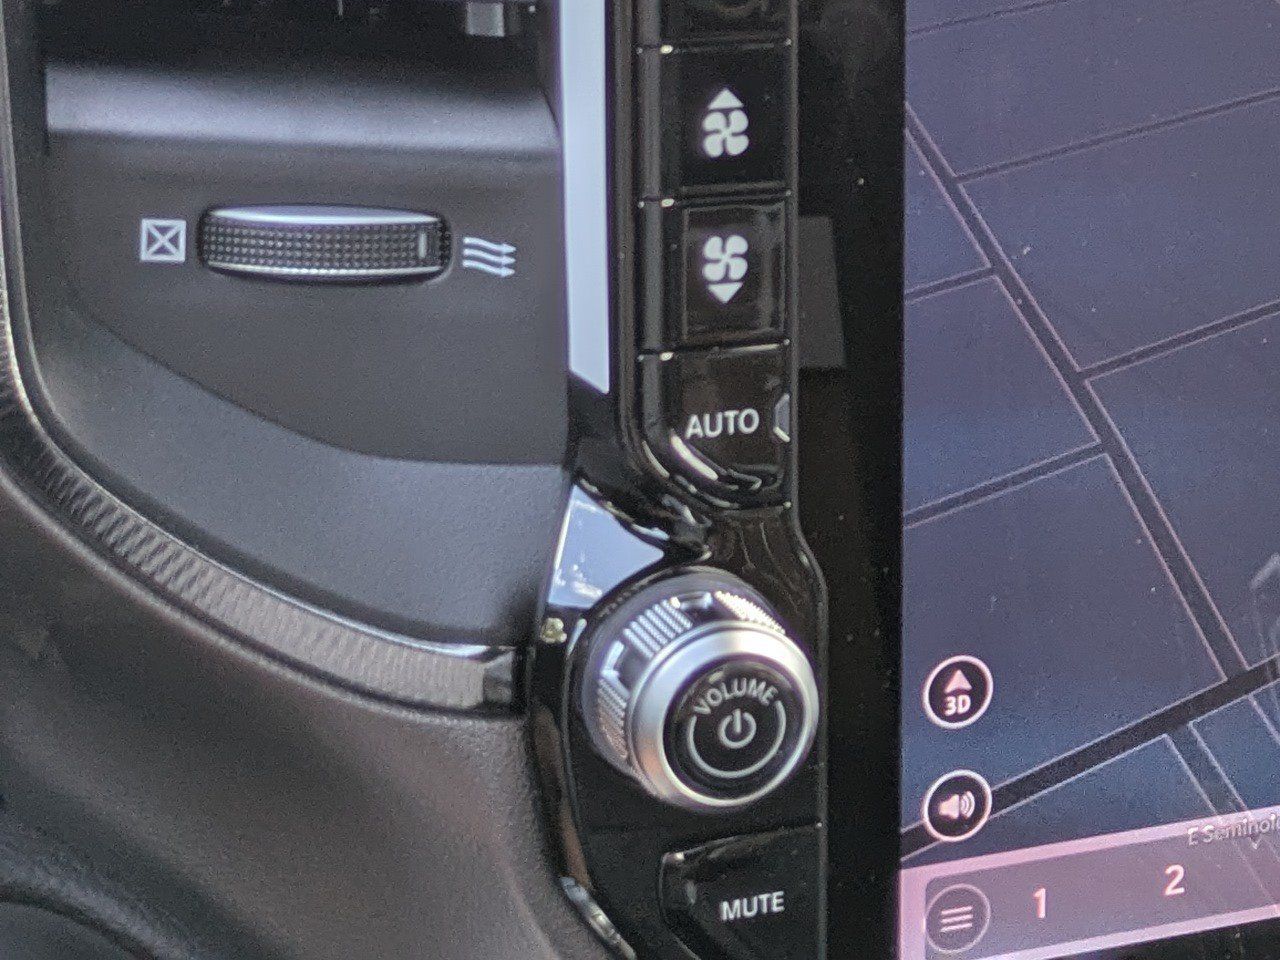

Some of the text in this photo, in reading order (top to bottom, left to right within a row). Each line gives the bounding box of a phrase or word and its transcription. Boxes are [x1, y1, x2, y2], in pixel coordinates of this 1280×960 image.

[685, 409, 760, 439] AUTO
[694, 677, 778, 716] VOLUME
[945, 694, 971, 715] 3D
[719, 890, 785, 922] MUTE
[1033, 887, 1047, 919] 1
[1163, 865, 1186, 898] 2
